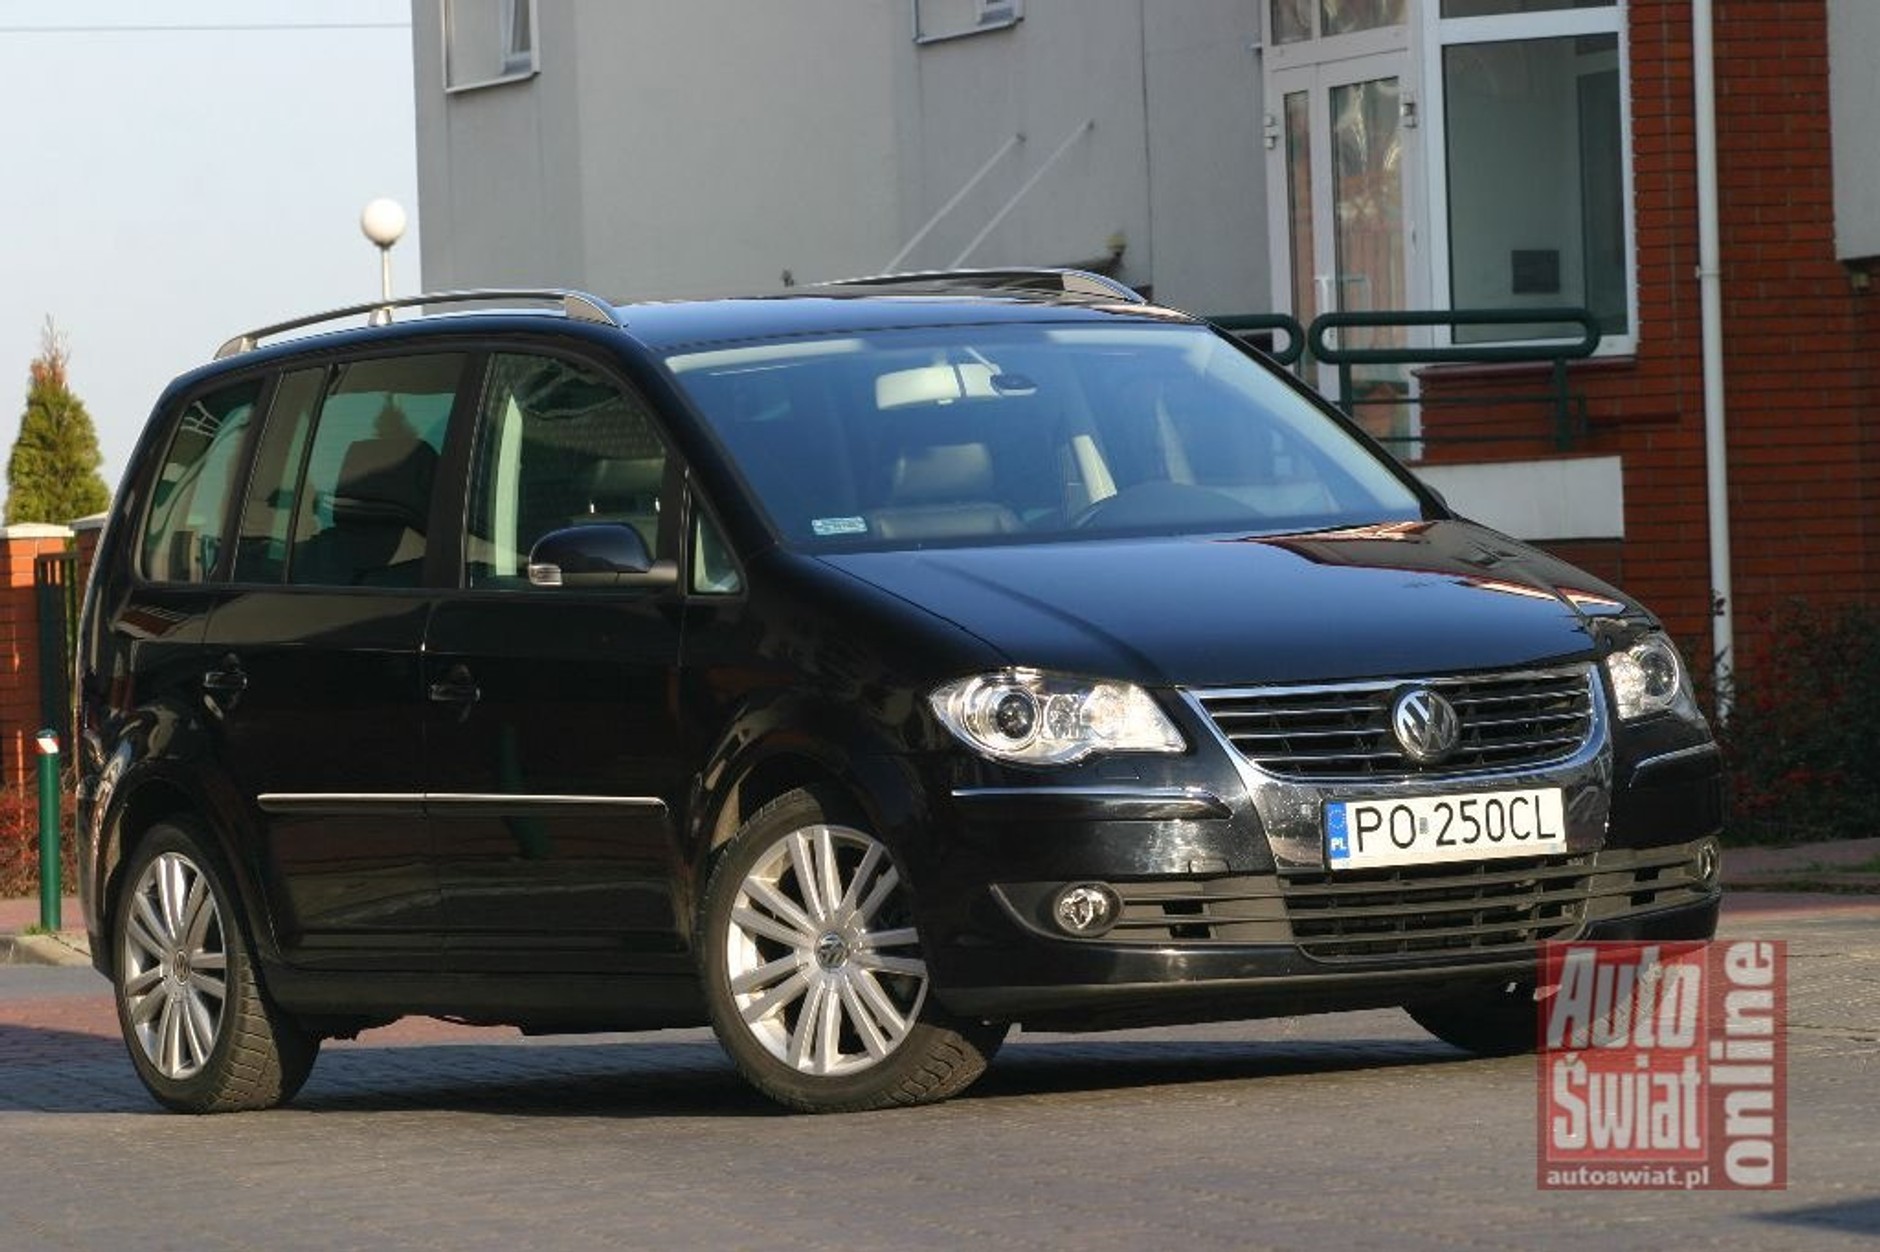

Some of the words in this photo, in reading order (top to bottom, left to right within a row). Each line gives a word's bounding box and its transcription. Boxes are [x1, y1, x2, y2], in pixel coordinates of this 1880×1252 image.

[1355, 804, 1417, 853] PO
[1433, 795, 1557, 847] 250CL
[1331, 837, 1348, 851] PL
